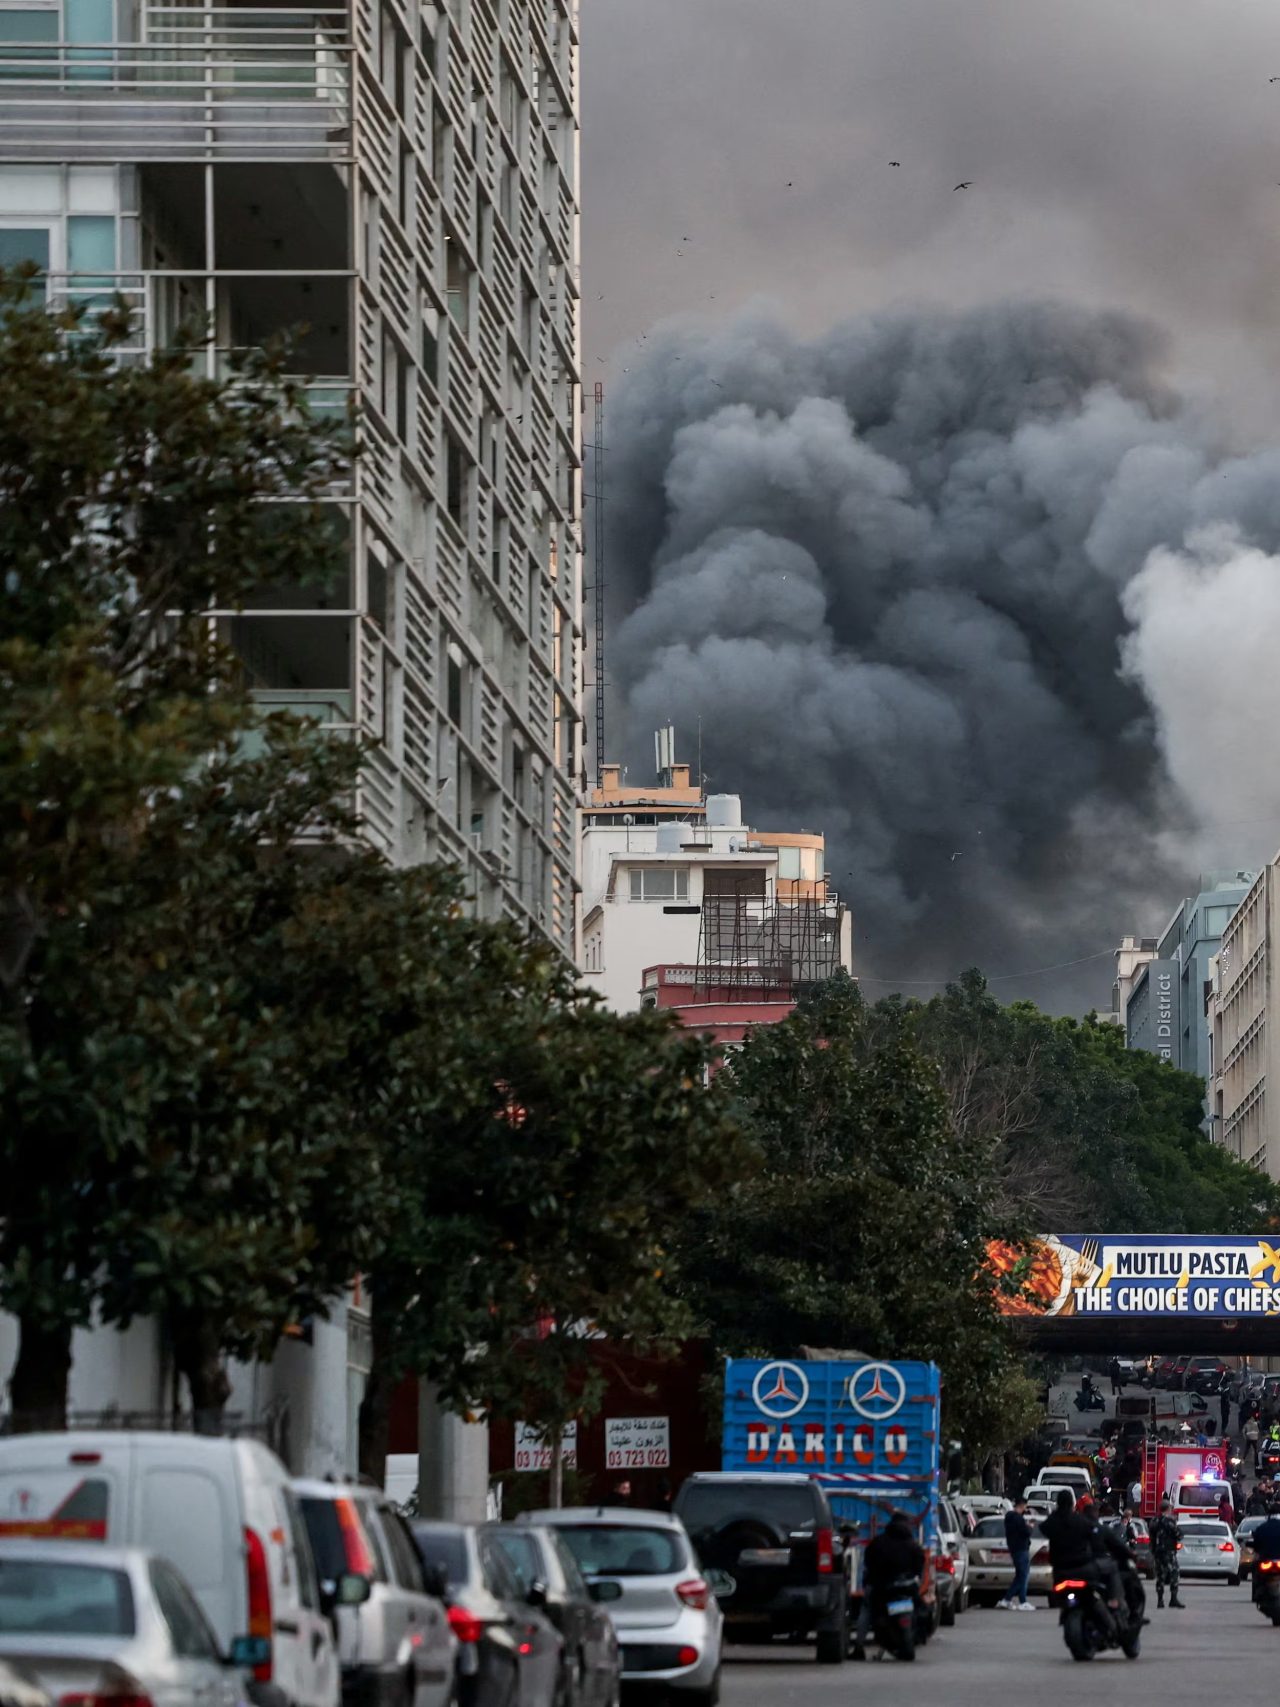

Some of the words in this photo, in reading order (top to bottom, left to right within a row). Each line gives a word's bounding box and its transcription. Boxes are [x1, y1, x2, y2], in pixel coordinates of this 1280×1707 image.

[1156, 973, 1171, 1037] District
[1116, 1252, 1183, 1275] MUTLU
[1189, 1252, 1250, 1275] PASTA
[1075, 1287, 1112, 1311] THE
[1117, 1287, 1189, 1312] CHOICE
[1193, 1287, 1220, 1311] OF
[746, 1422, 908, 1466] DARICO
[516, 1450, 530, 1468] 03
[608, 1450, 622, 1466] 03
[625, 1449, 645, 1466] 723
[647, 1448, 667, 1465] 022
